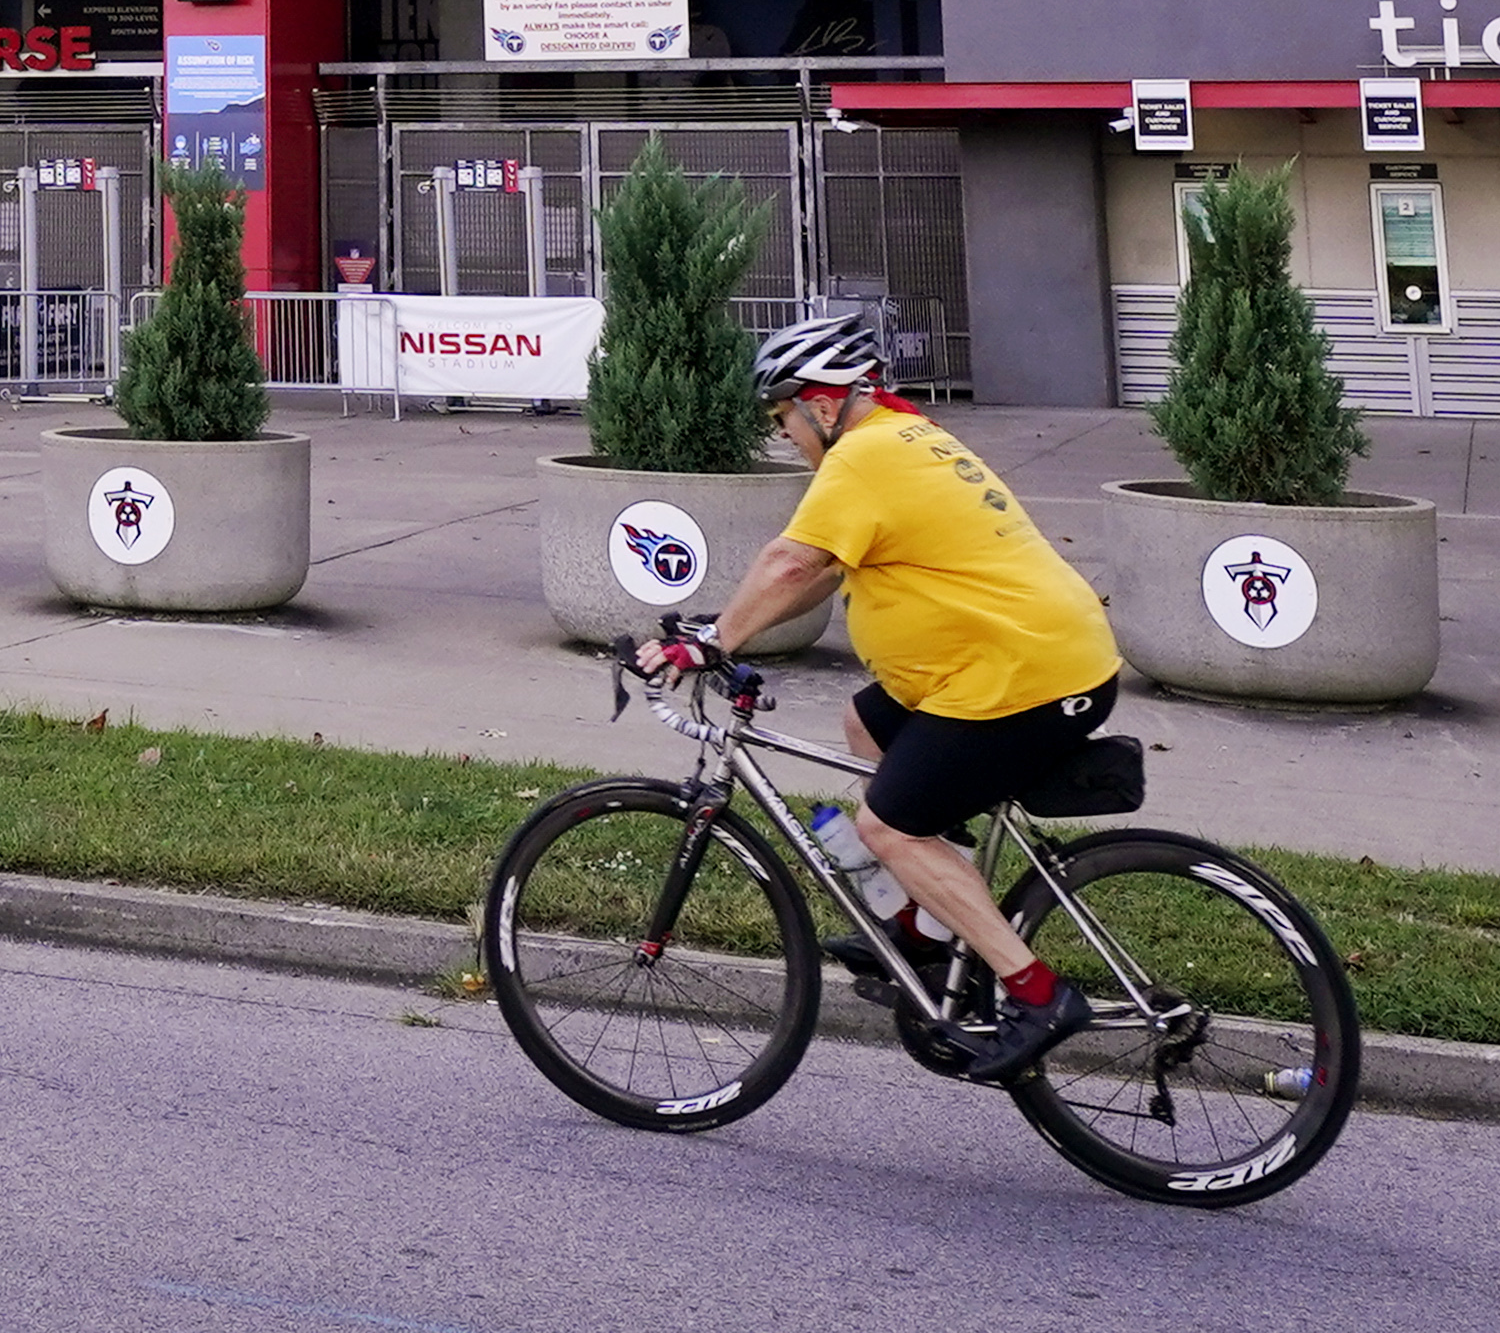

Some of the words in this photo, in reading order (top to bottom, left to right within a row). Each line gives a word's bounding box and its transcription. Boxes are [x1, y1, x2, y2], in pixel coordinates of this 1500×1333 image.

[524, 23, 559, 31] ALWAYS
[1403, 203, 1409, 211] 2
[426, 320, 489, 330] WELCOME
[499, 322, 514, 331] TO
[400, 332, 541, 356] NISSAN
[427, 358, 515, 370] STADIUM
[1189, 862, 1319, 967] ZIPP
[655, 1081, 743, 1115] ZIPP
[1167, 1132, 1298, 1192] ZIPP
